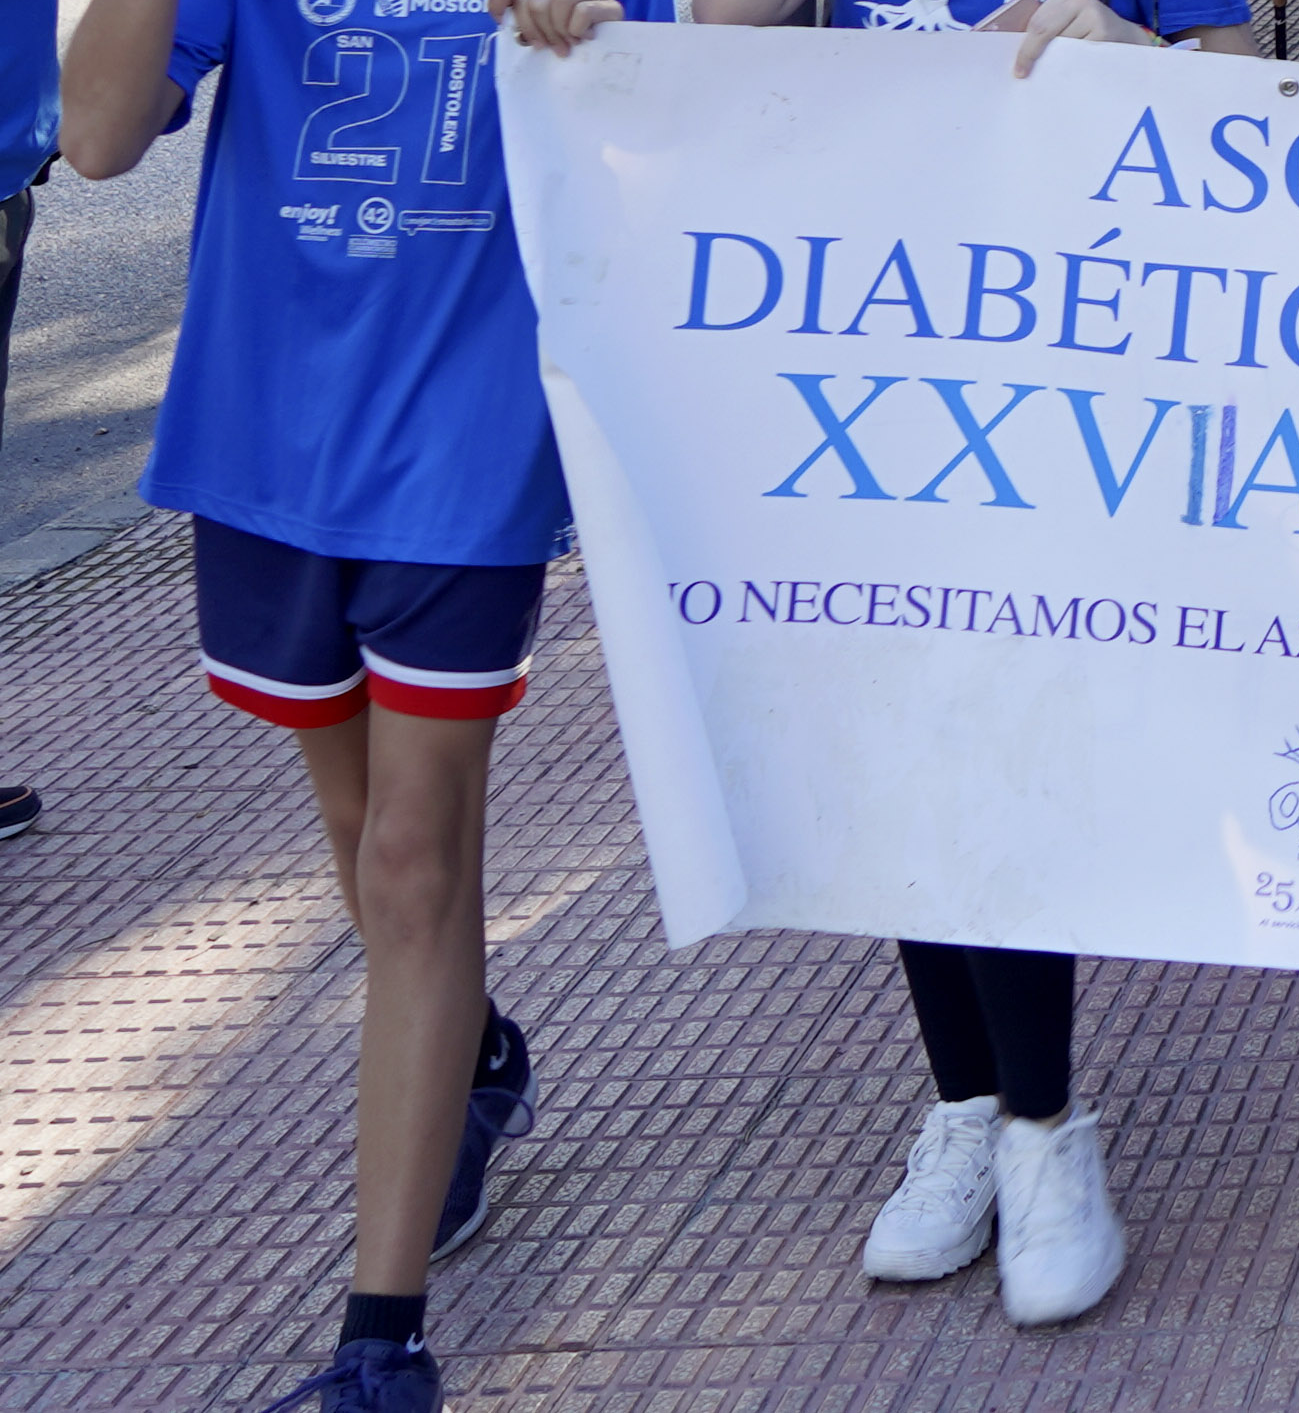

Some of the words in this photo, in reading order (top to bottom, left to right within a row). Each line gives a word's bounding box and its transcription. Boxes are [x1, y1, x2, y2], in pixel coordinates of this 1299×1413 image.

[336, 35, 374, 49] SAN
[310, 151, 388, 168] SILVESTRE
[279, 203, 341, 225] enjoy!
[363, 207, 390, 225] 42
[735, 579, 1159, 647] NECESITAMOS
[1173, 606, 1244, 654] EL
[1255, 871, 1295, 912] 25
